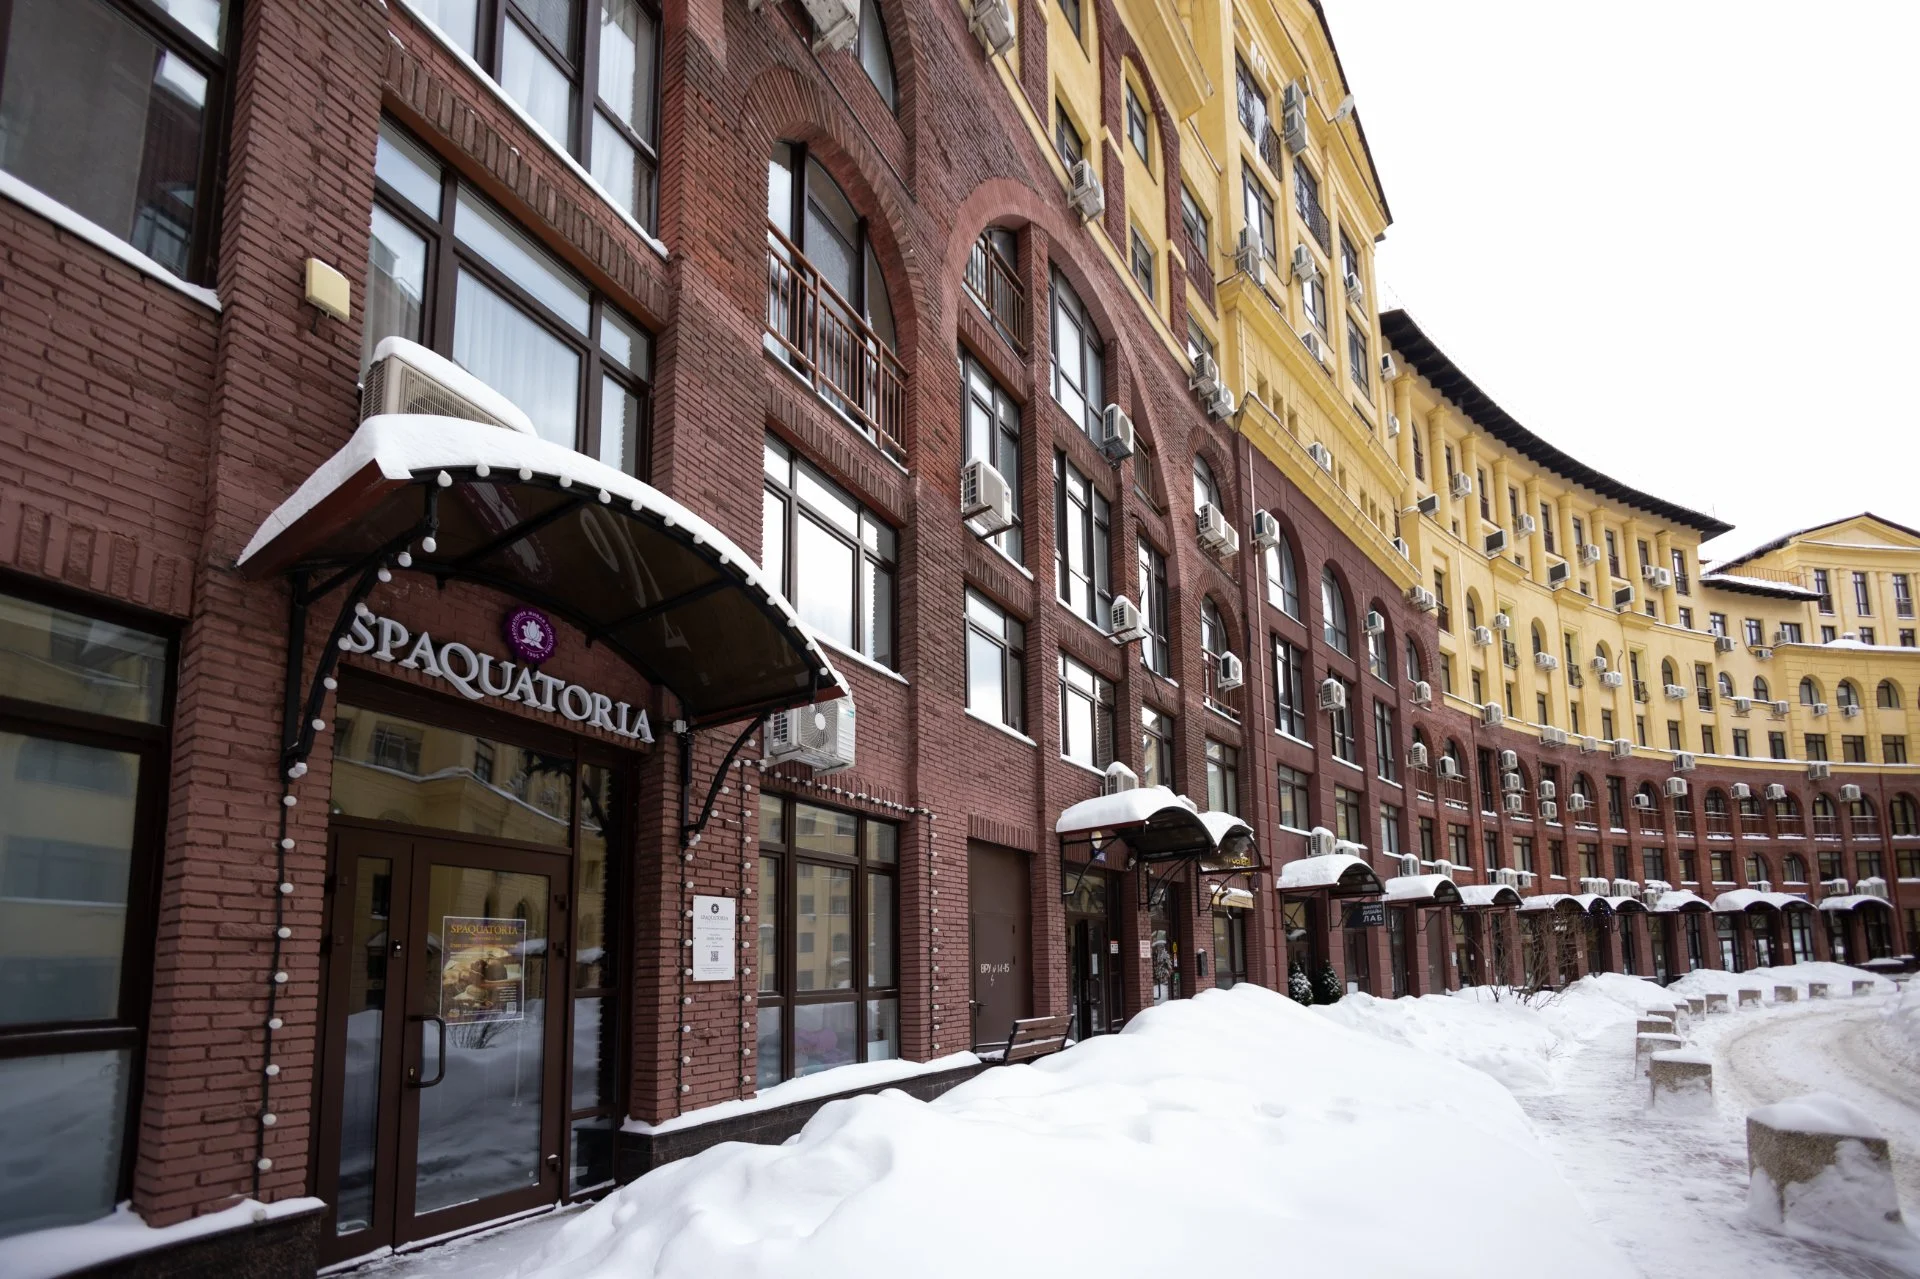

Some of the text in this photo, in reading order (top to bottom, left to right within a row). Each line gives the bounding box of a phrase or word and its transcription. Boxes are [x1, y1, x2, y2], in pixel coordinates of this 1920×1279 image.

[346, 611, 655, 743] SPAQUATORIA
[1362, 914, 1383, 923] ЛАБ
[450, 923, 518, 936] SPAQUATORIA
